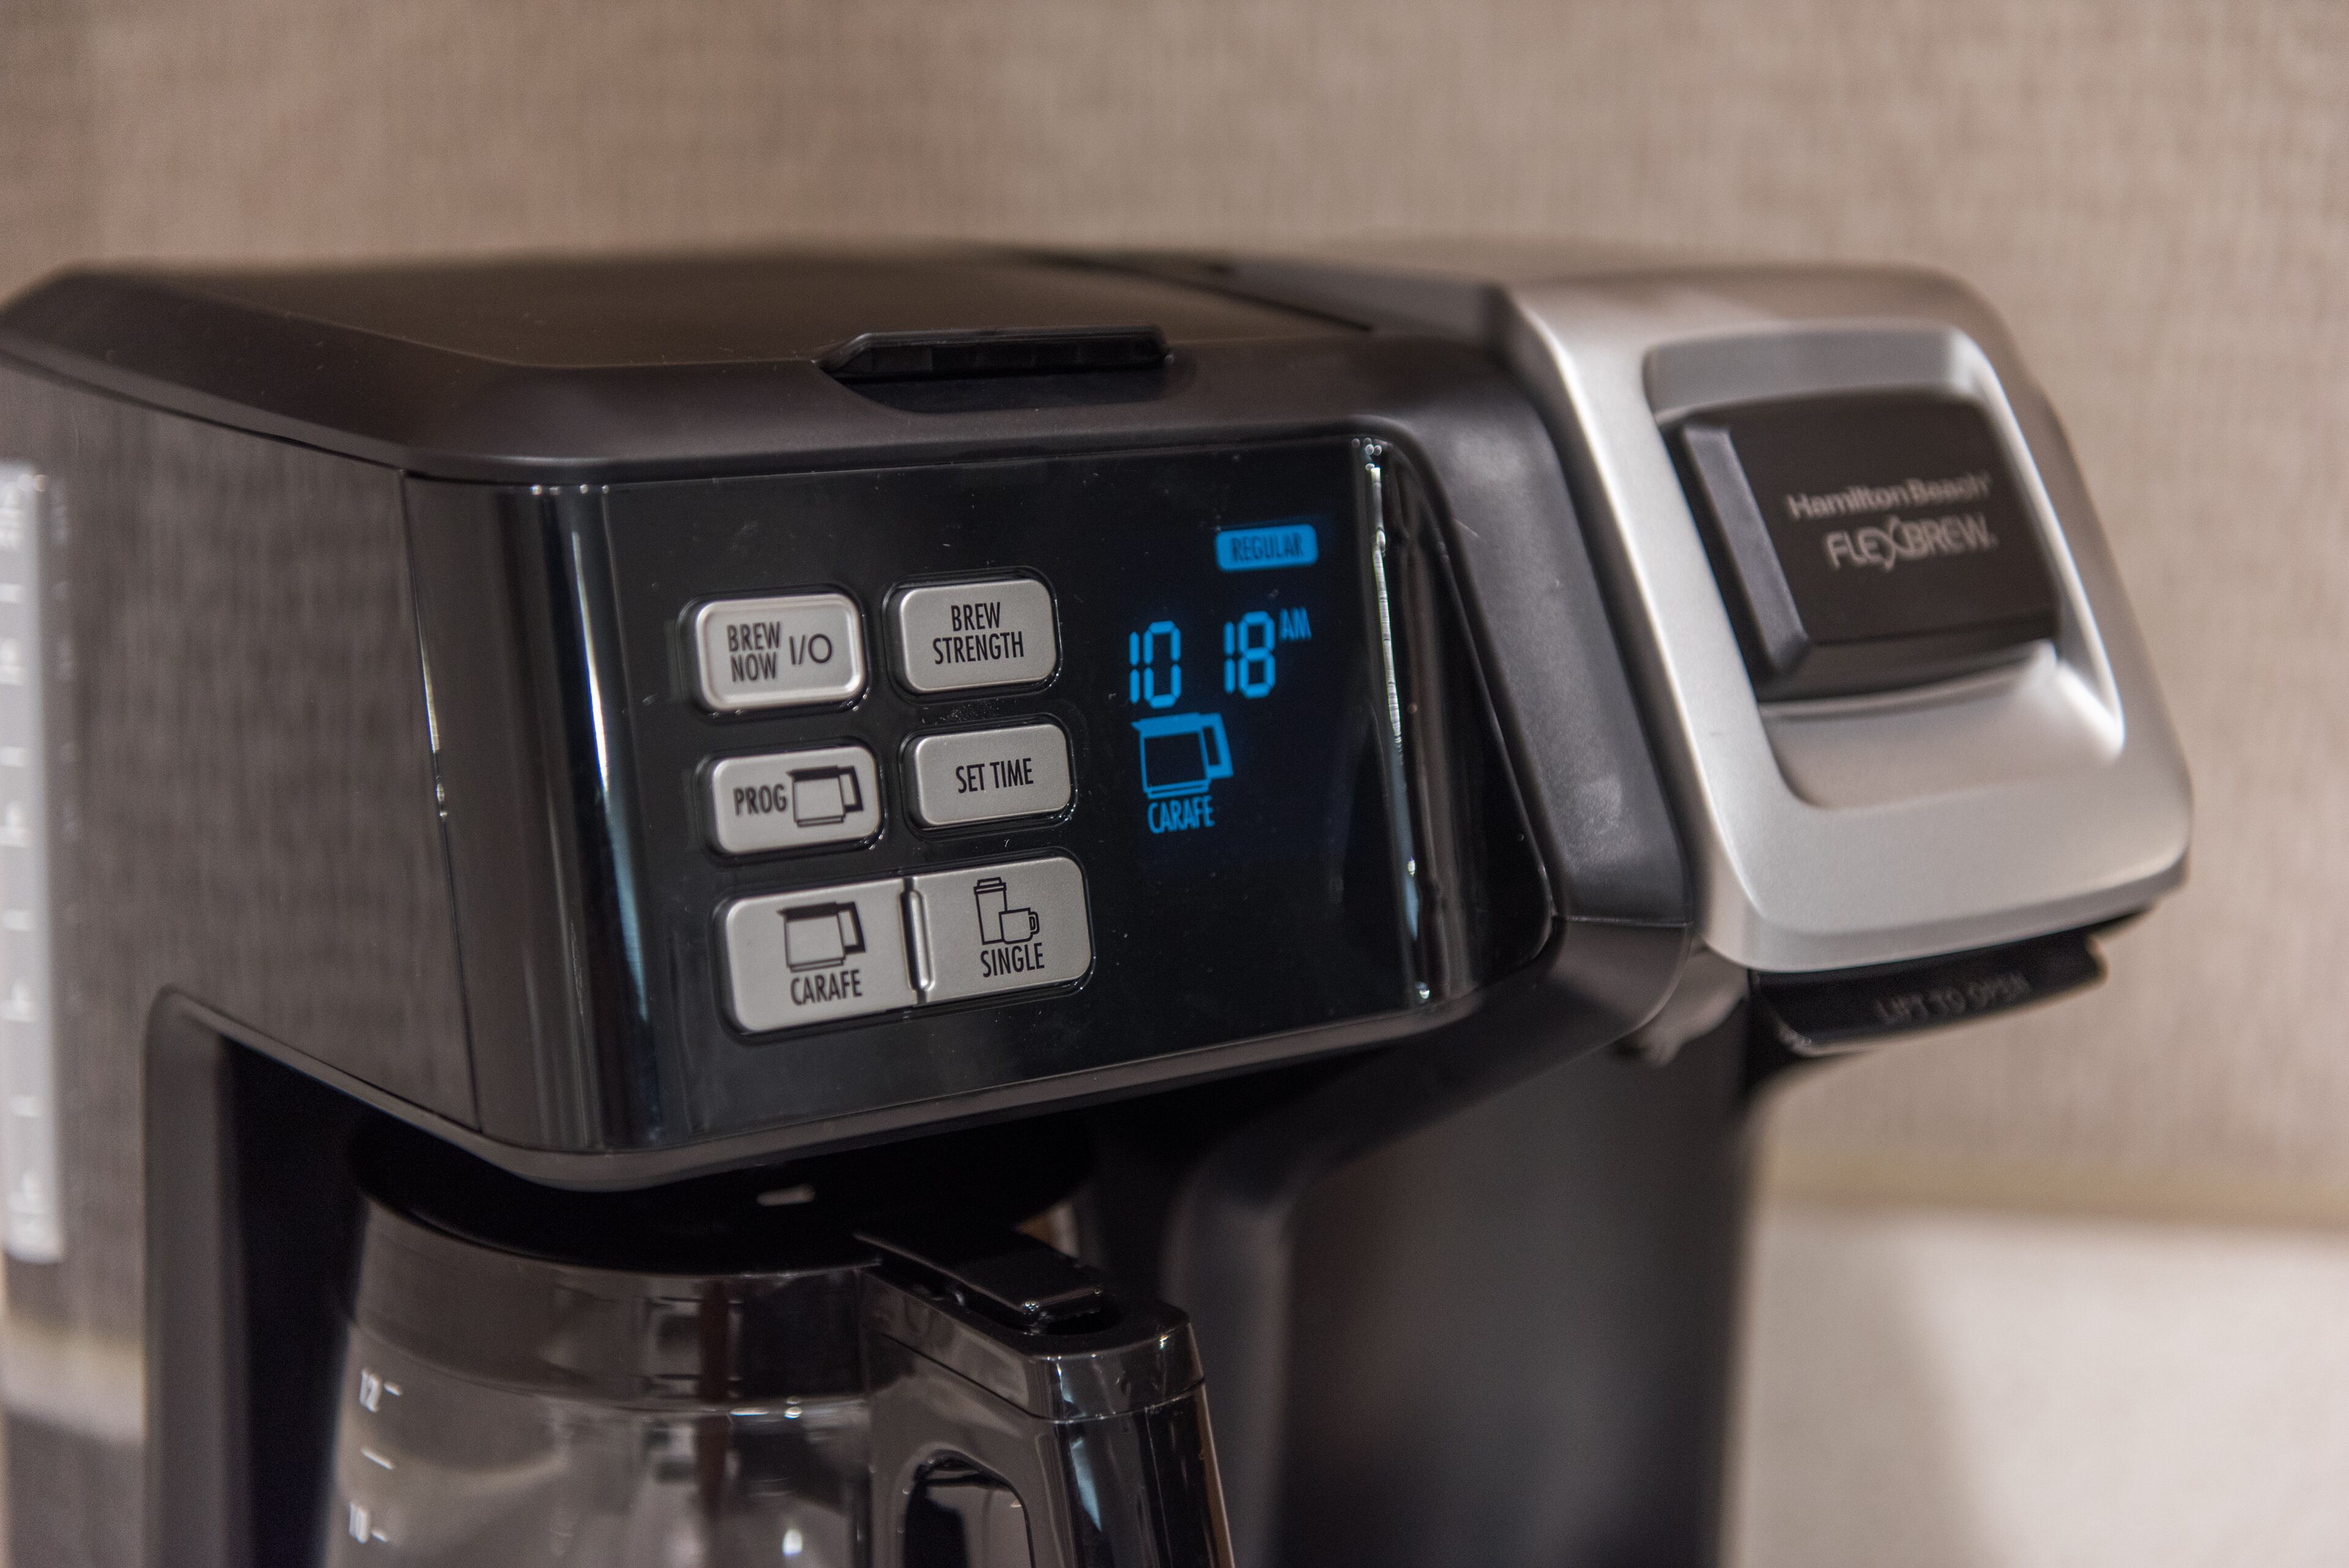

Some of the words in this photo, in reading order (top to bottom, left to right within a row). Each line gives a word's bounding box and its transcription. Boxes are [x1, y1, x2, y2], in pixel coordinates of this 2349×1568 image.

[1786, 485, 1909, 519] Hamilton
[1231, 532, 1303, 562] REGULAR
[951, 601, 1001, 632] BREW
[727, 621, 781, 652] BREW
[932, 631, 1024, 665] STRENGTH
[730, 652, 777, 682] NOW
[1129, 620, 1182, 709] 10
[1223, 611, 1276, 699] 18
[1278, 606, 1312, 641] AM
[956, 763, 985, 793] SET
[989, 757, 1034, 789] TIME
[734, 784, 787, 816] PROG
[1148, 795, 1215, 833] CARAFE
[981, 942, 1045, 978] SINGLE
[790, 969, 862, 1006] CARAFE
